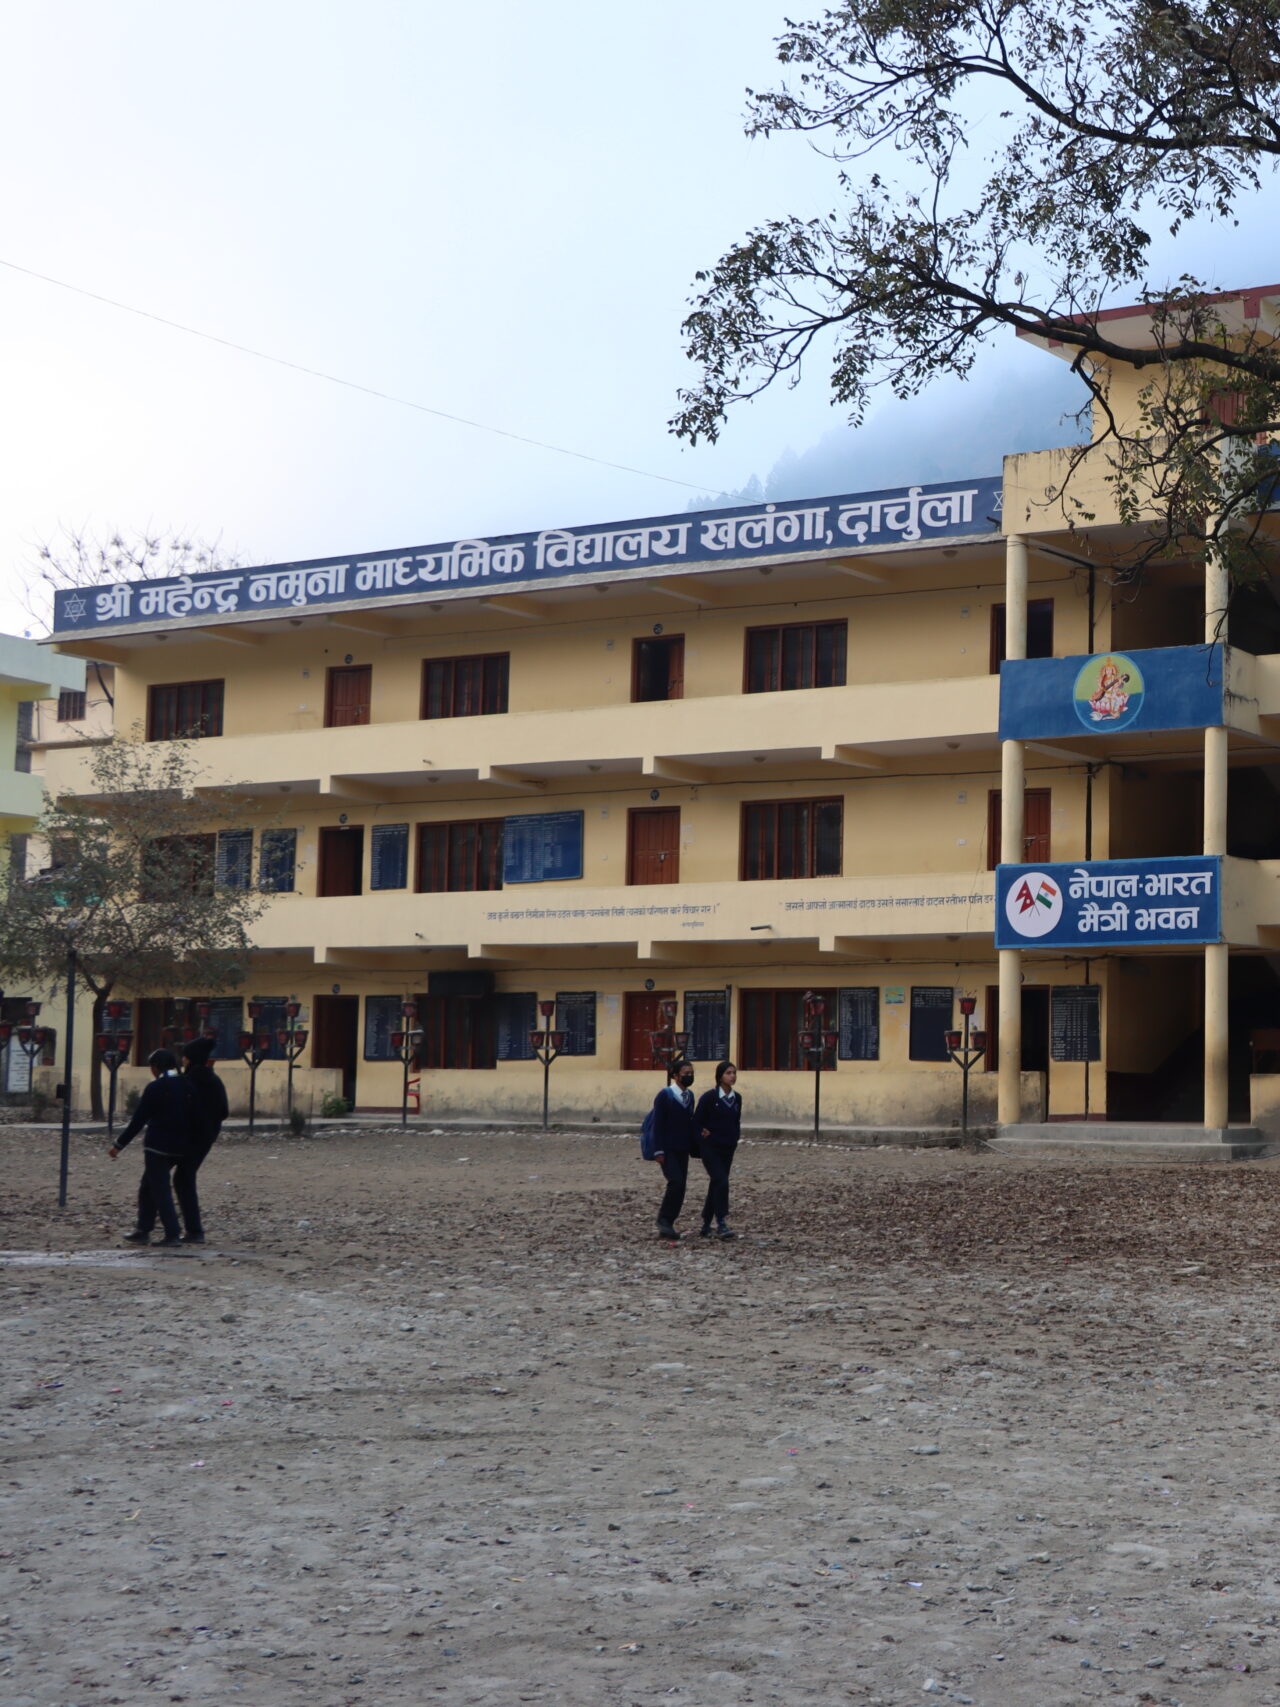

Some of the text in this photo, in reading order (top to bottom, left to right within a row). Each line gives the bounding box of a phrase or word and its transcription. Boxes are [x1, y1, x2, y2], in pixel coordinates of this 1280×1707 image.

[96, 583, 134, 621] श्री
[139, 576, 244, 617] महेन्द्र
[249, 564, 350, 606] नमुना
[355, 539, 526, 591] माध्यमिक
[533, 522, 693, 570] विद्यालय
[837, 487, 979, 543] दार्चुला
[1078, 902, 1200, 933] मैत्री भवन
